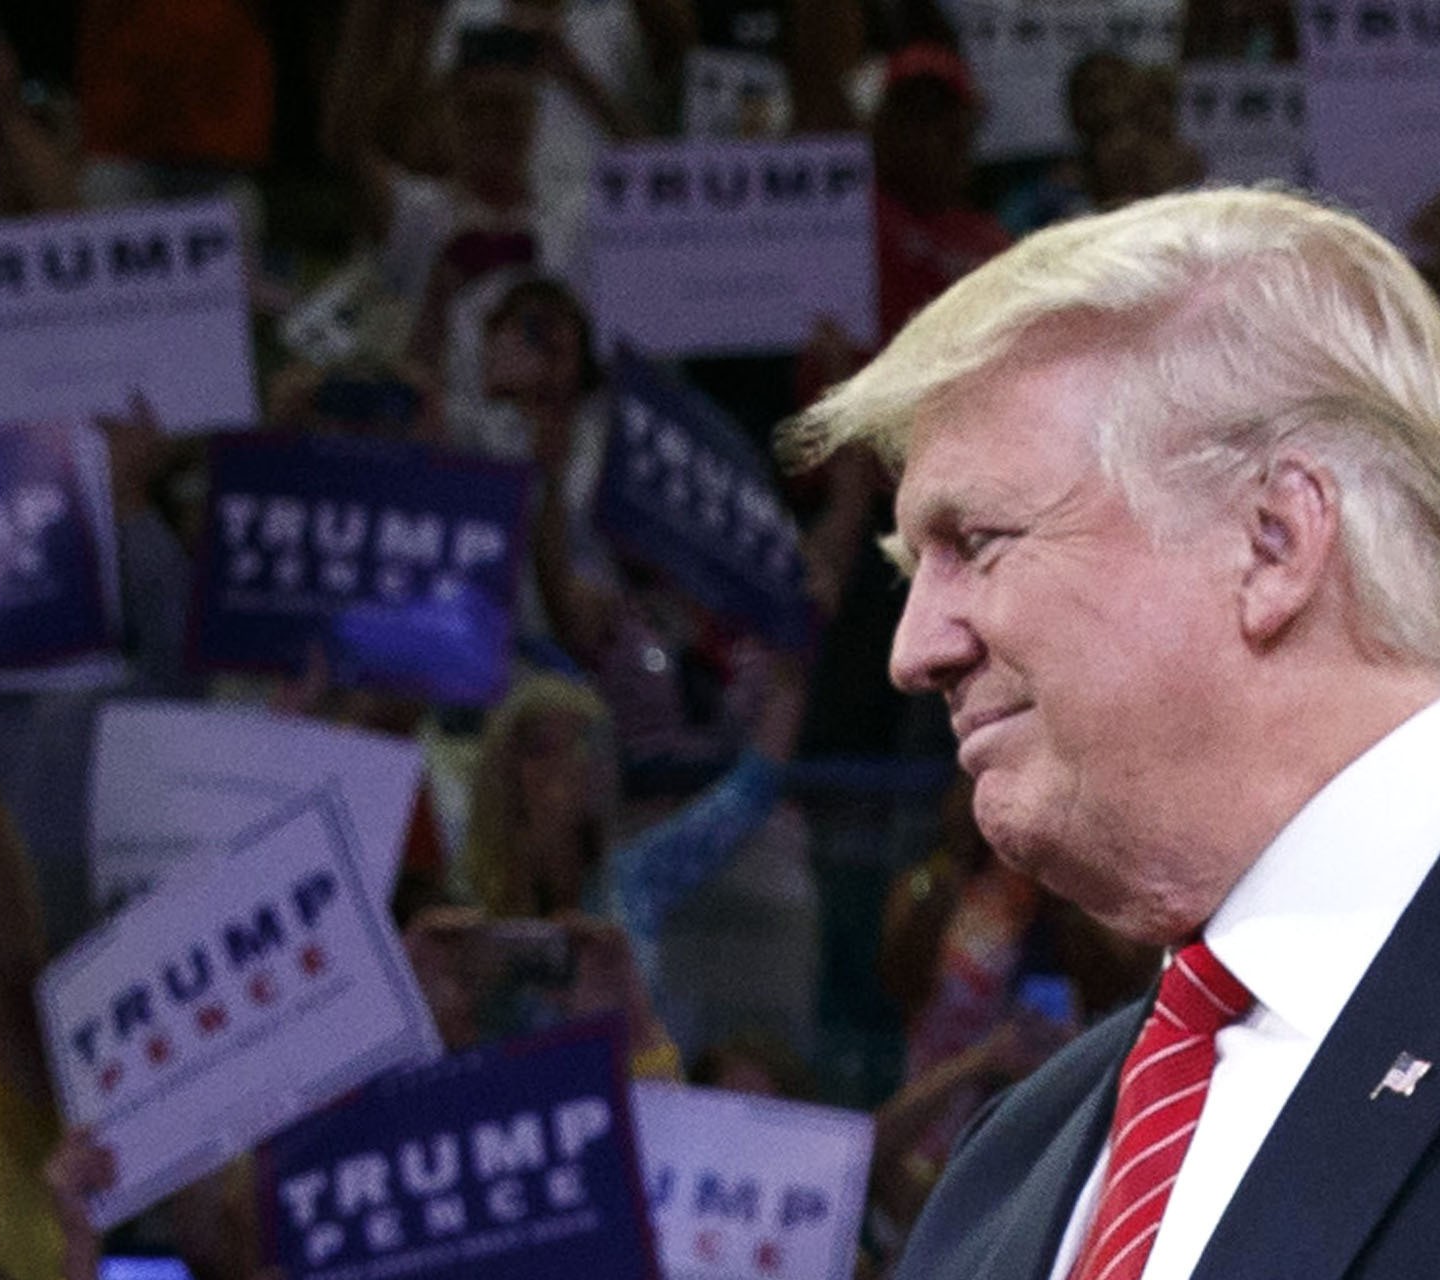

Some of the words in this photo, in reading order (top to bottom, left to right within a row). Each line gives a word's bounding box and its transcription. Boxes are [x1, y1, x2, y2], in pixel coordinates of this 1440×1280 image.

[601, 162, 862, 209] TRUMP
[221, 493, 509, 567] TRUMP
[73, 870, 337, 1065] TRUMP
[279, 1097, 614, 1227] TRUMP
[304, 1162, 587, 1266] PENCE
